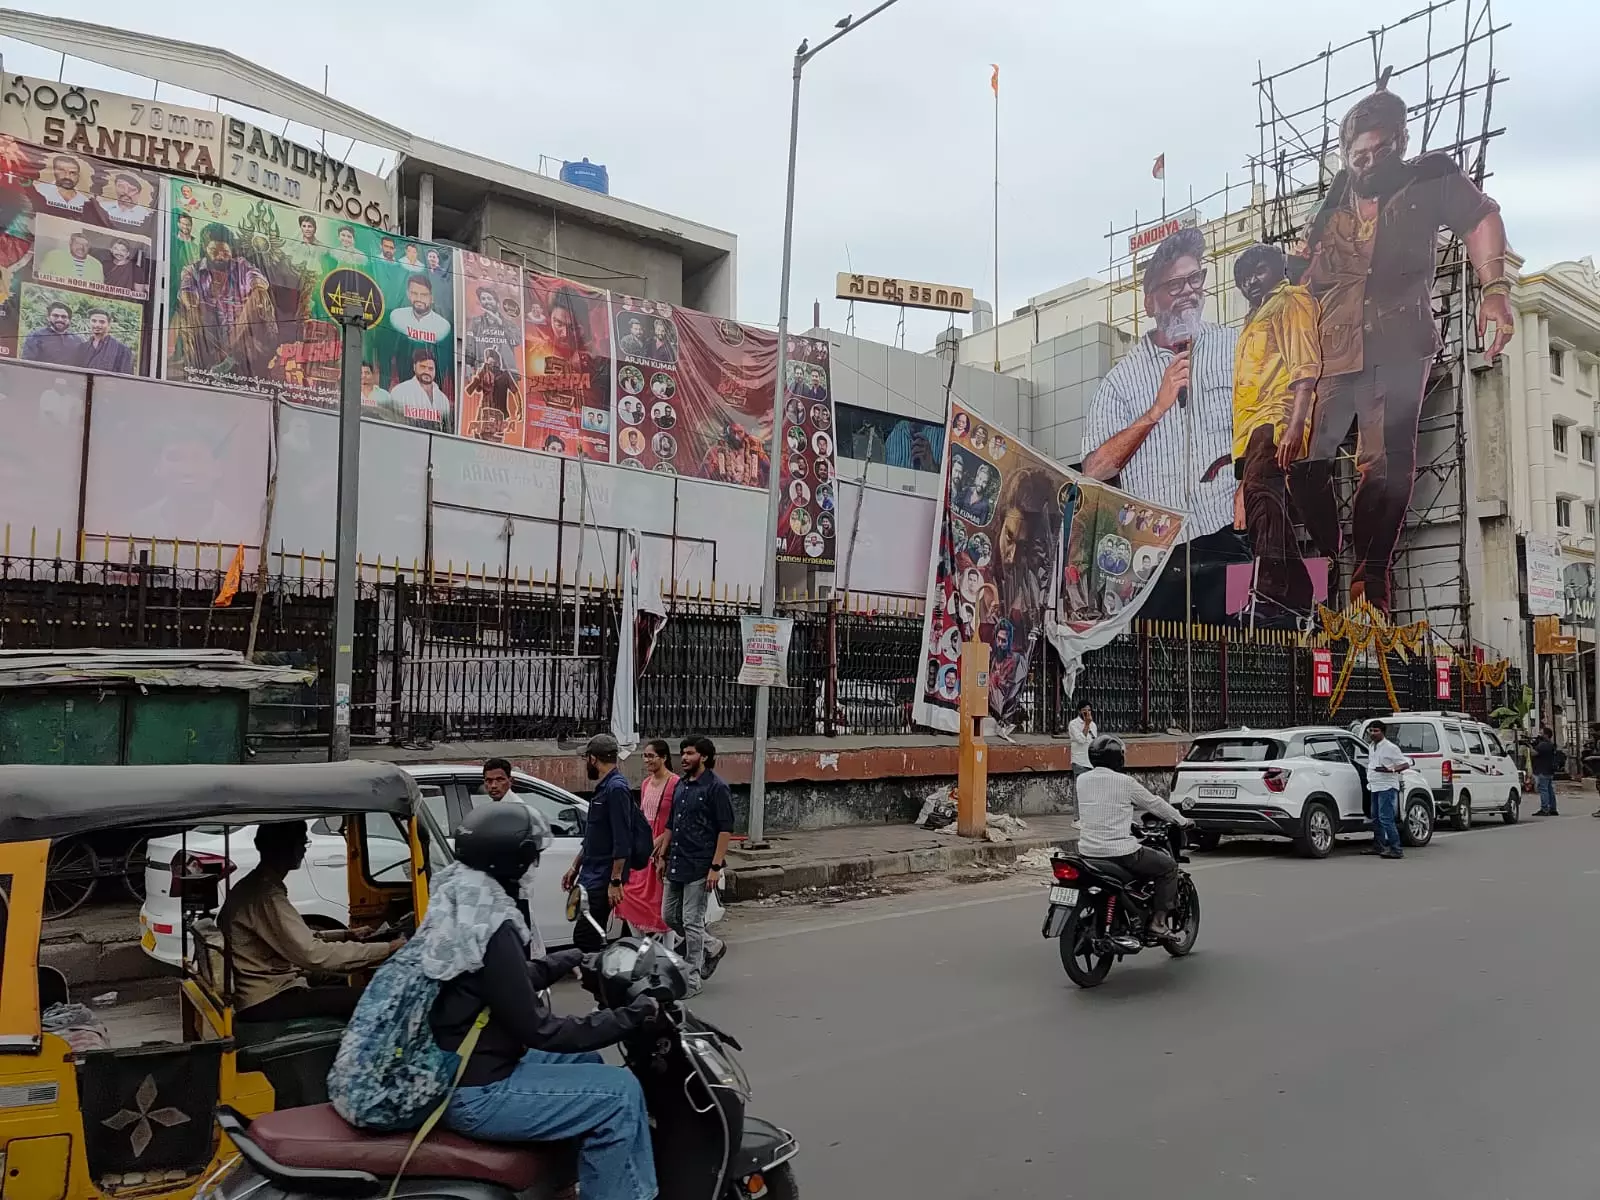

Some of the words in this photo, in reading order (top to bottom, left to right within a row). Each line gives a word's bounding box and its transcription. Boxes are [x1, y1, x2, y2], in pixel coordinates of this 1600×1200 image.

[4, 76, 99, 125] సంధ్య
[131, 103, 215, 140] 70mm
[43, 116, 215, 178] SANDHYA
[227, 117, 361, 196] SANDHYA
[231, 153, 301, 200] 70mm
[1130, 219, 1180, 250] SANDHYA
[407, 327, 436, 342] Varun
[625, 356, 650, 366] ARJUN
[650, 360, 677, 371] KUMAR
[404, 405, 441, 423] Karthik
[1317, 676, 1330, 694] IN
[1439, 682, 1449, 696] IN
